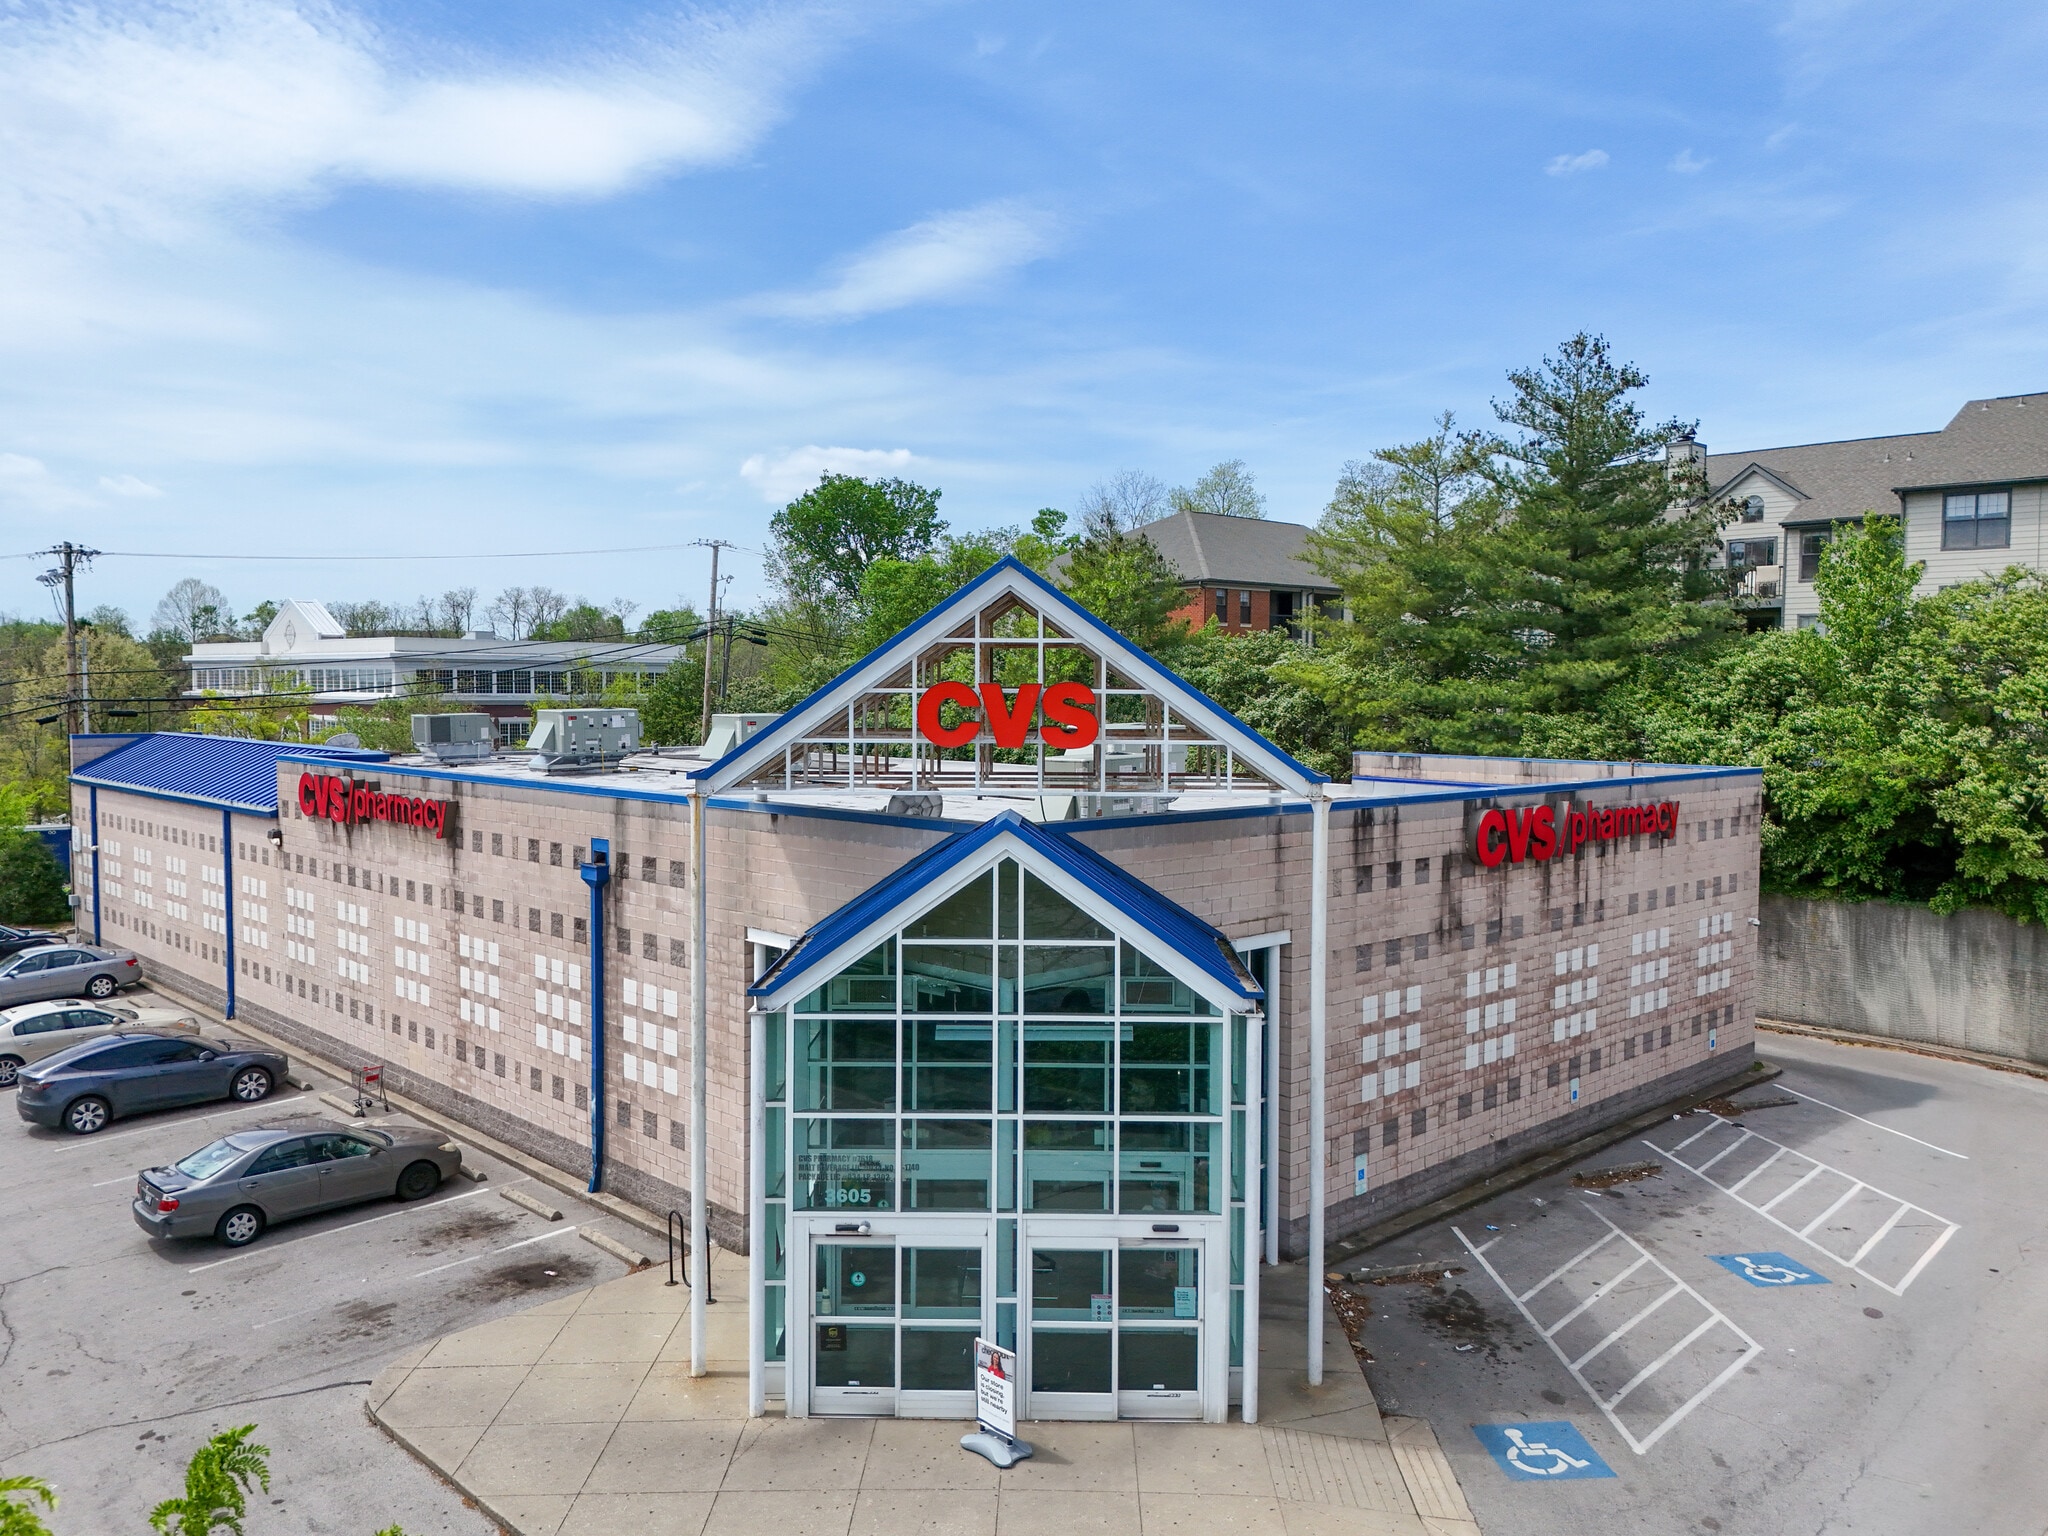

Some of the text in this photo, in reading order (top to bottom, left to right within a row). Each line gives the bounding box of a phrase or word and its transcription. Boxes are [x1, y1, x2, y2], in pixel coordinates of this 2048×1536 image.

[917, 681, 1099, 749] CVS
[298, 772, 446, 840] CVS/pharmacy
[1477, 800, 1680, 868] CVS/pharmacy
[798, 1154, 812, 1162] CVS
[813, 1154, 850, 1163] PHARMACY
[825, 1188, 872, 1203] 3605
[980, 1373, 1004, 1390] Our store
[981, 1388, 989, 1397] but
[990, 1401, 1008, 1415] nearby
